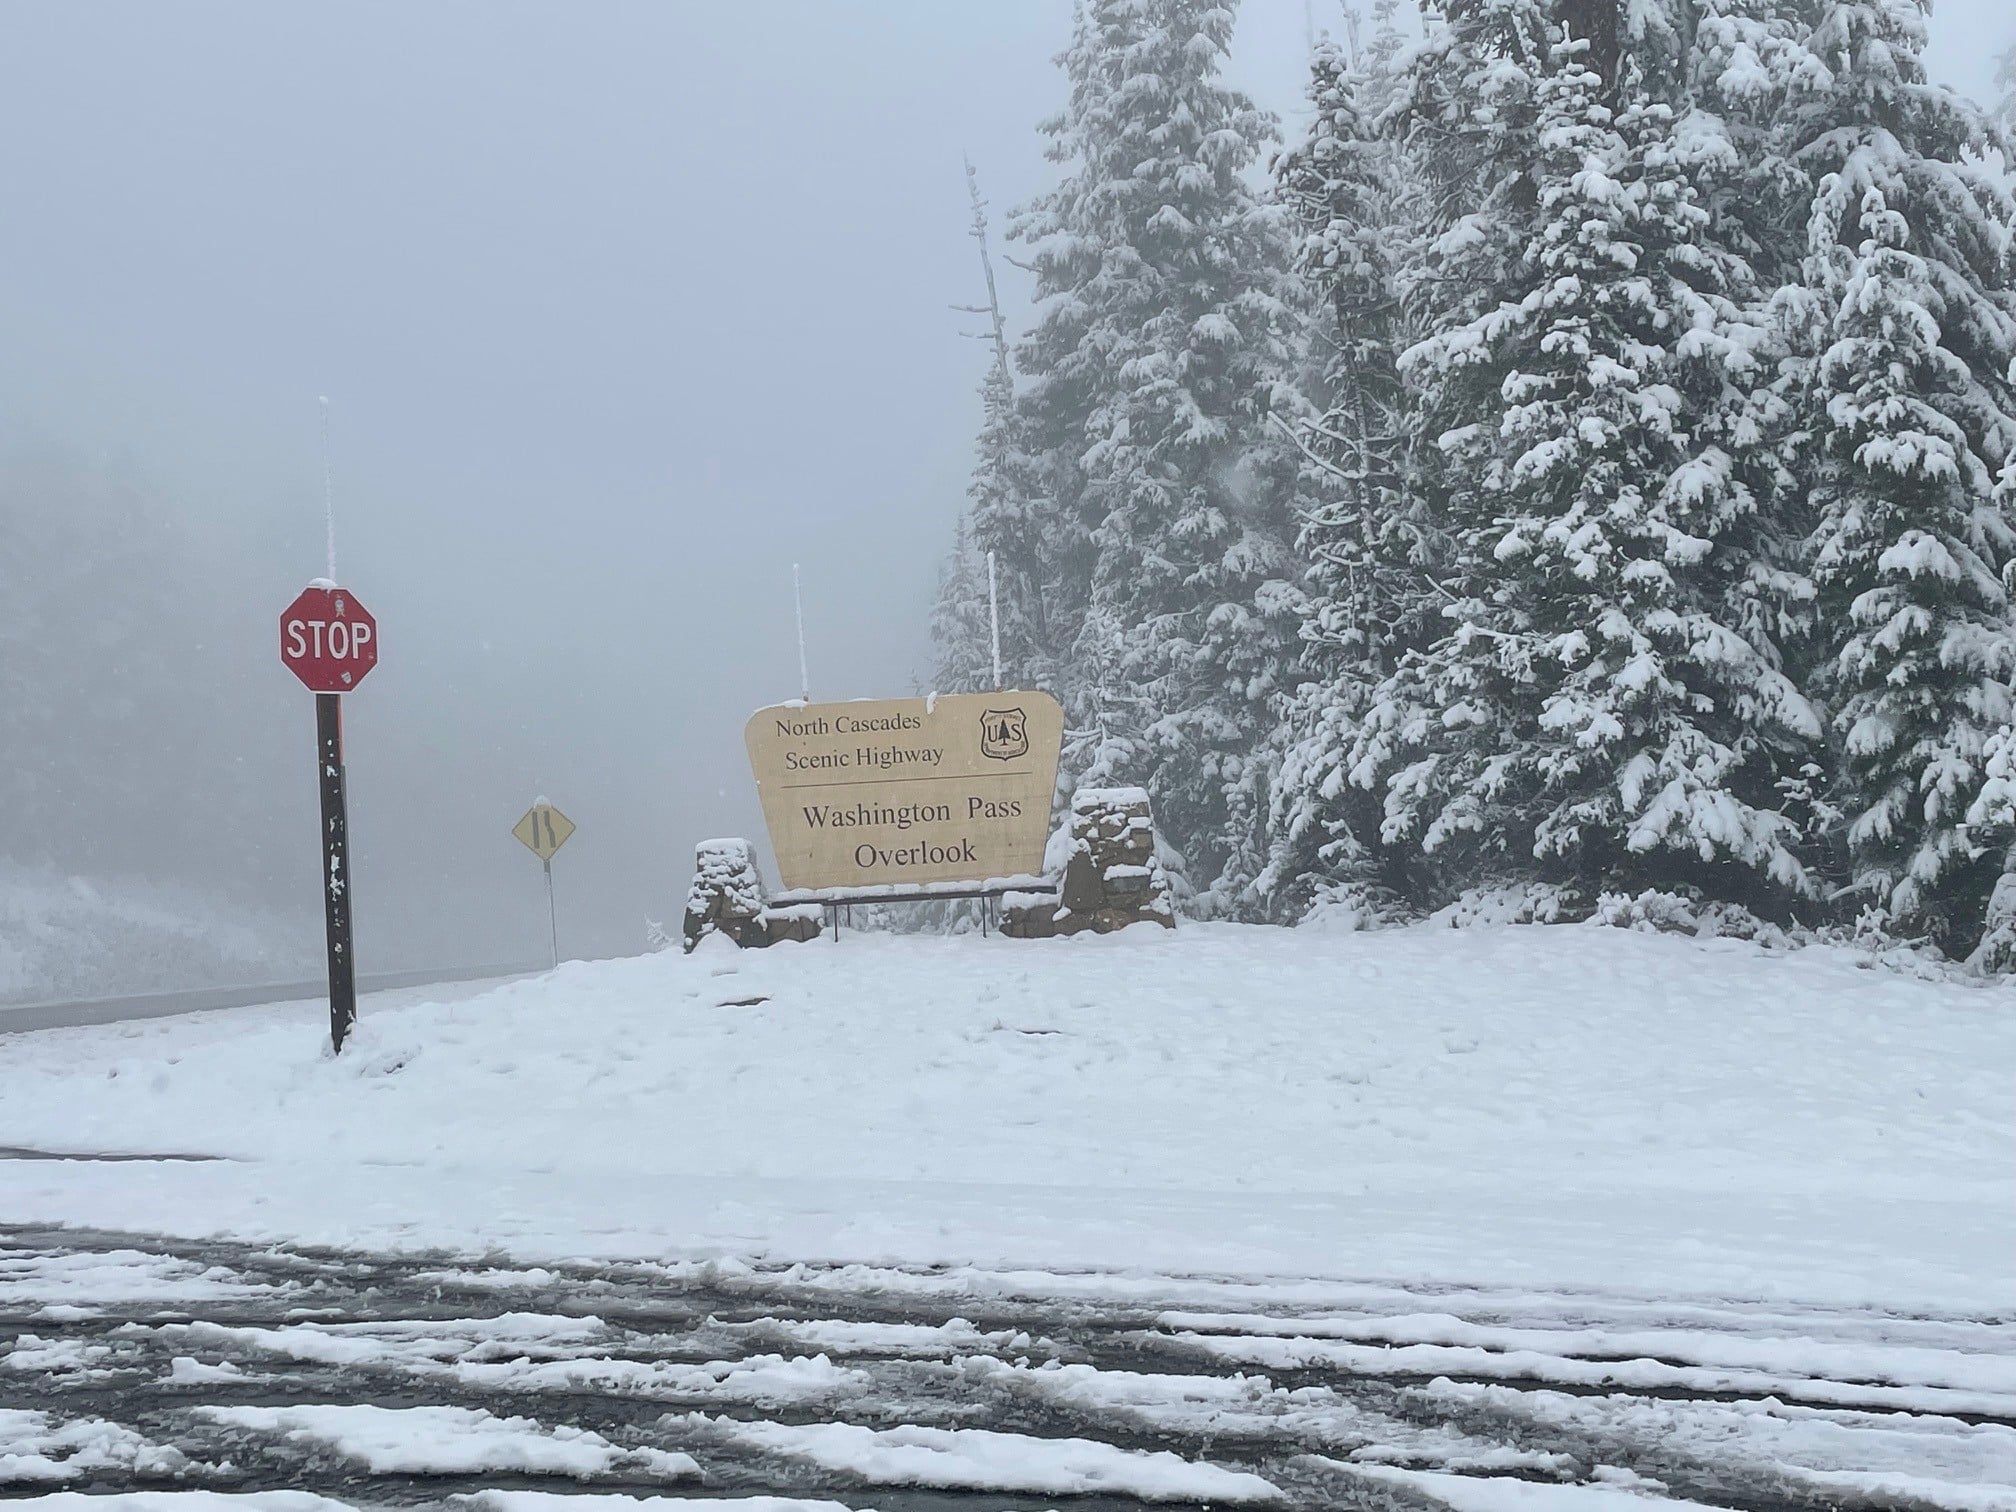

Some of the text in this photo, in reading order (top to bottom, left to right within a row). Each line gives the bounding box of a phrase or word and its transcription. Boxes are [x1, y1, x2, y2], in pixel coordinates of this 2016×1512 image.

[287, 619, 371, 659] STOP
[776, 713, 921, 737] North Cascades
[786, 747, 944, 770] Scenic Highway
[803, 797, 1022, 829] Washington Pass
[855, 838, 977, 868] Overlook
